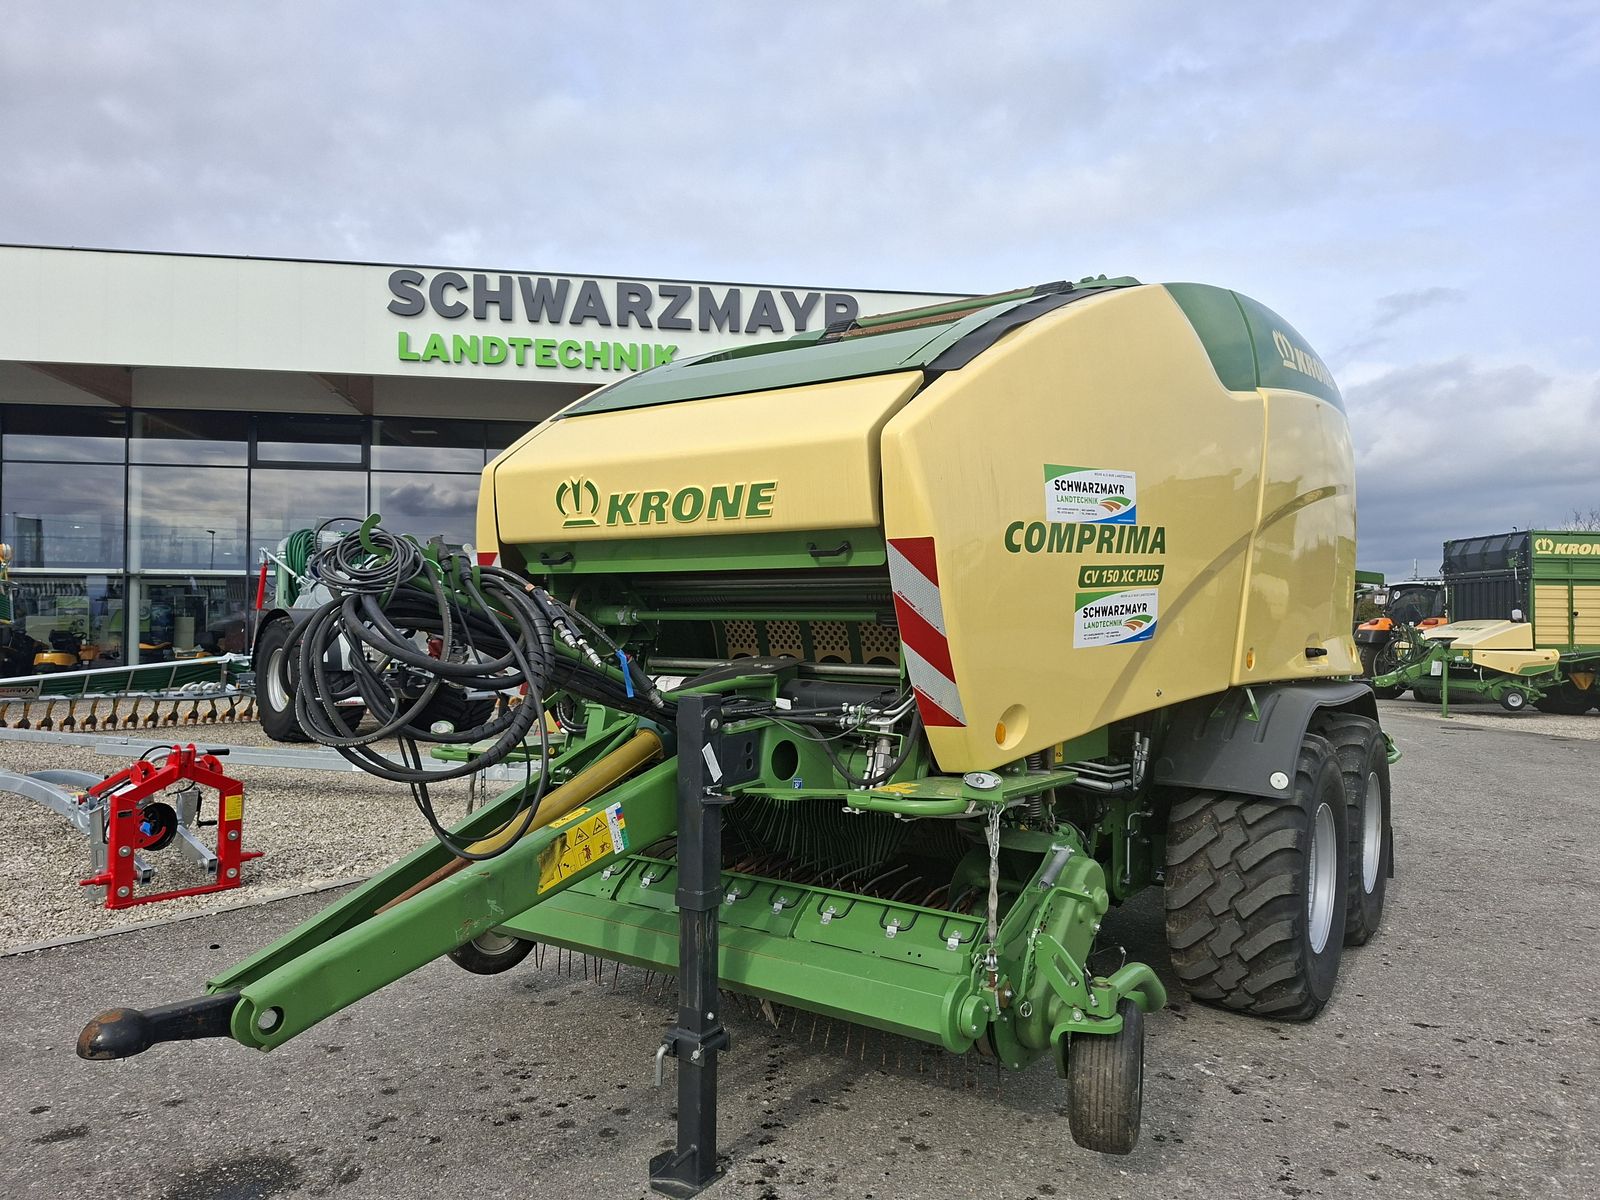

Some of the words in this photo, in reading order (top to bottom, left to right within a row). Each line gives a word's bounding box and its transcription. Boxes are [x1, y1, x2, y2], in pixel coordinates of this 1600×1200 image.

[387, 269, 859, 333] SCHWARZMAYR
[398, 331, 678, 372] LANDTECHNIK
[1054, 480, 1125, 495] SCHWARZMAYR
[606, 480, 778, 526] KRONE
[1056, 495, 1099, 504] LANDTECHNIK
[1004, 521, 1166, 554] COMPRIMA
[1084, 570, 1099, 584] CV
[1102, 570, 1120, 583] 150
[1121, 569, 1136, 583] XC
[1136, 569, 1160, 582] PLUS
[1082, 603, 1148, 618] SCHWARZMAYR
[1083, 619, 1123, 629] LANDTECHNIK
